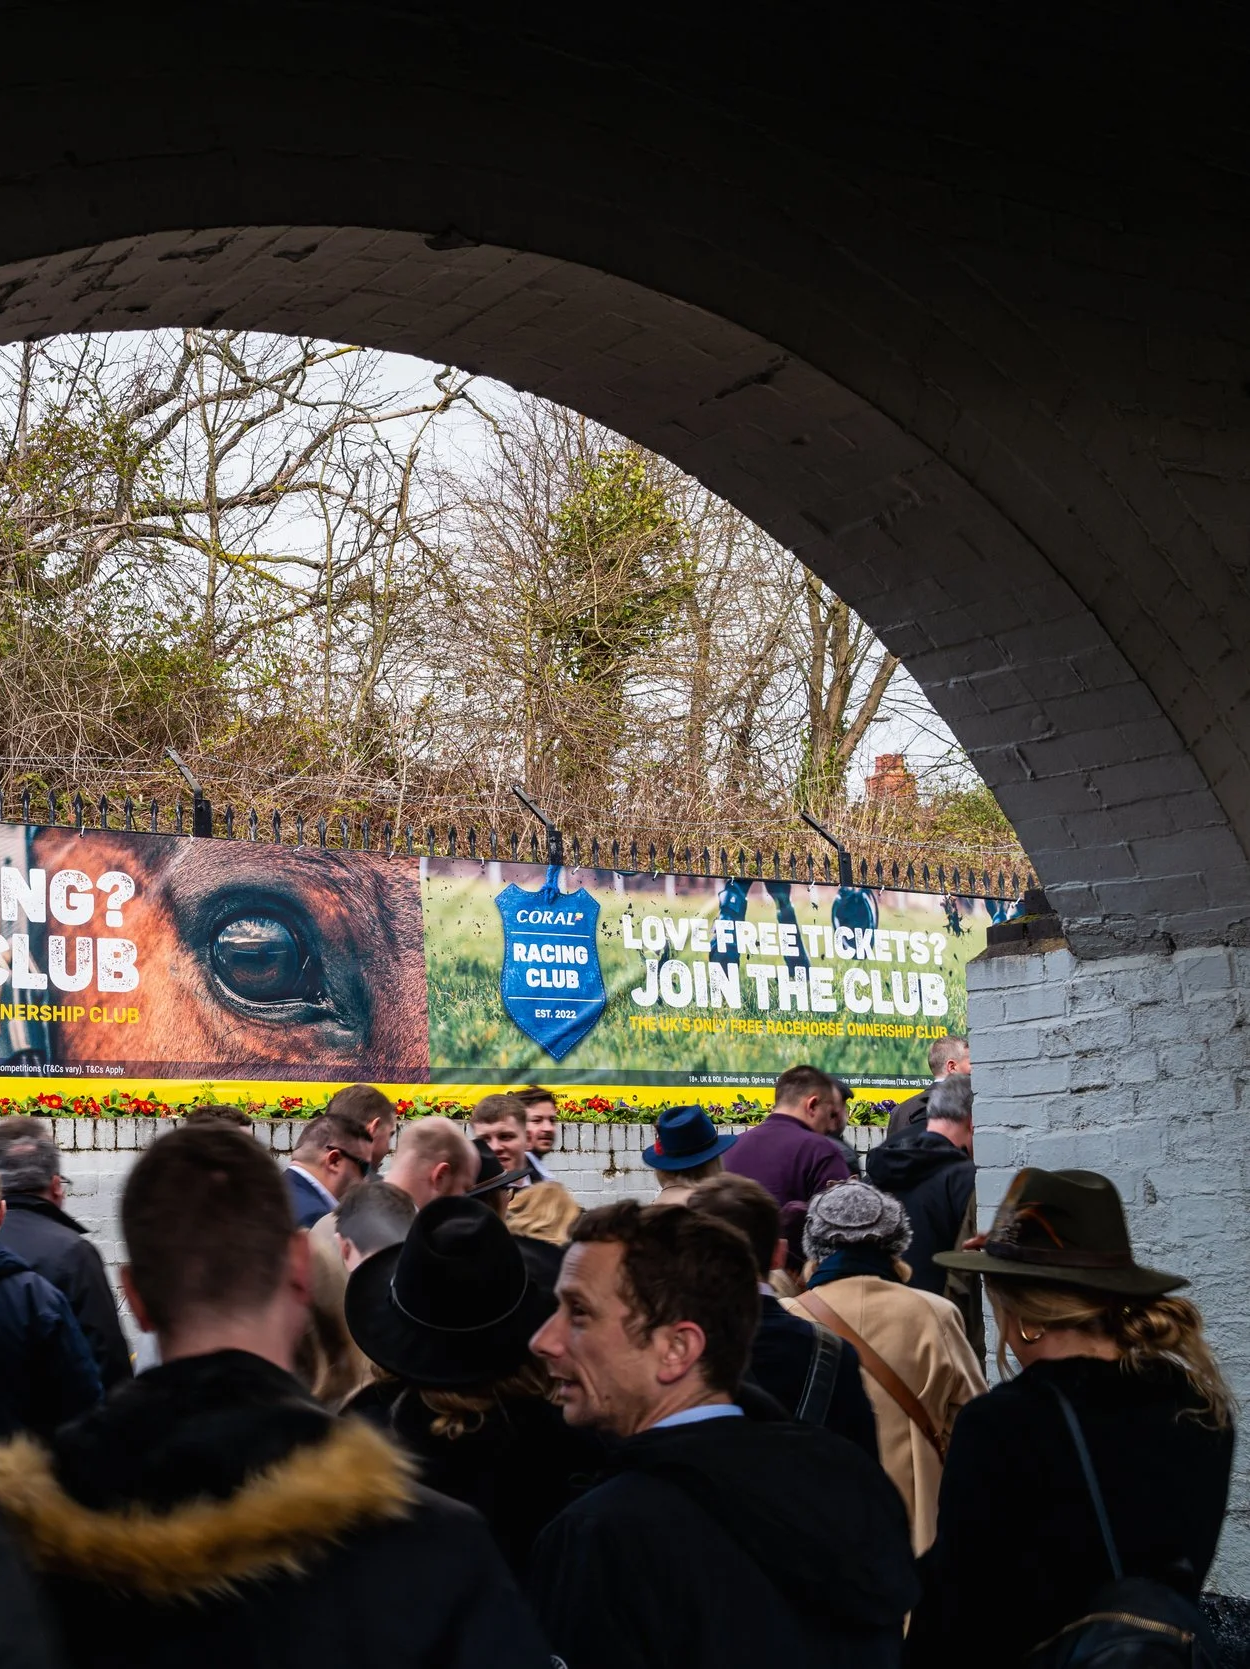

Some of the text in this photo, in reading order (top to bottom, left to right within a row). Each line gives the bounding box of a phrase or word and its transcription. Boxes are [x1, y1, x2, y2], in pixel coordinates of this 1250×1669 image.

[516, 910, 576, 926] CORAL
[622, 914, 947, 965] LOVE FREE TICKETS?
[513, 943, 588, 965] RACING
[526, 968, 579, 988] CLUB
[631, 958, 948, 1016] JOIN THE CLUB
[89, 1006, 140, 1024] CLUB
[535, 1009, 577, 1019] EST. 2022
[629, 1016, 657, 1031] THE
[659, 1017, 691, 1032] UK'S
[693, 1018, 728, 1033] ONLY
[730, 1019, 763, 1035] FREE
[767, 1020, 845, 1036] RACEHORSE
[847, 1022, 914, 1039] OWNERSHIP
[42, 1065, 64, 1074] (T&Cs
[65, 1066, 84, 1075] vary).
[85, 1066, 104, 1074] T&Cs
[105, 1066, 126, 1075] Apply.
